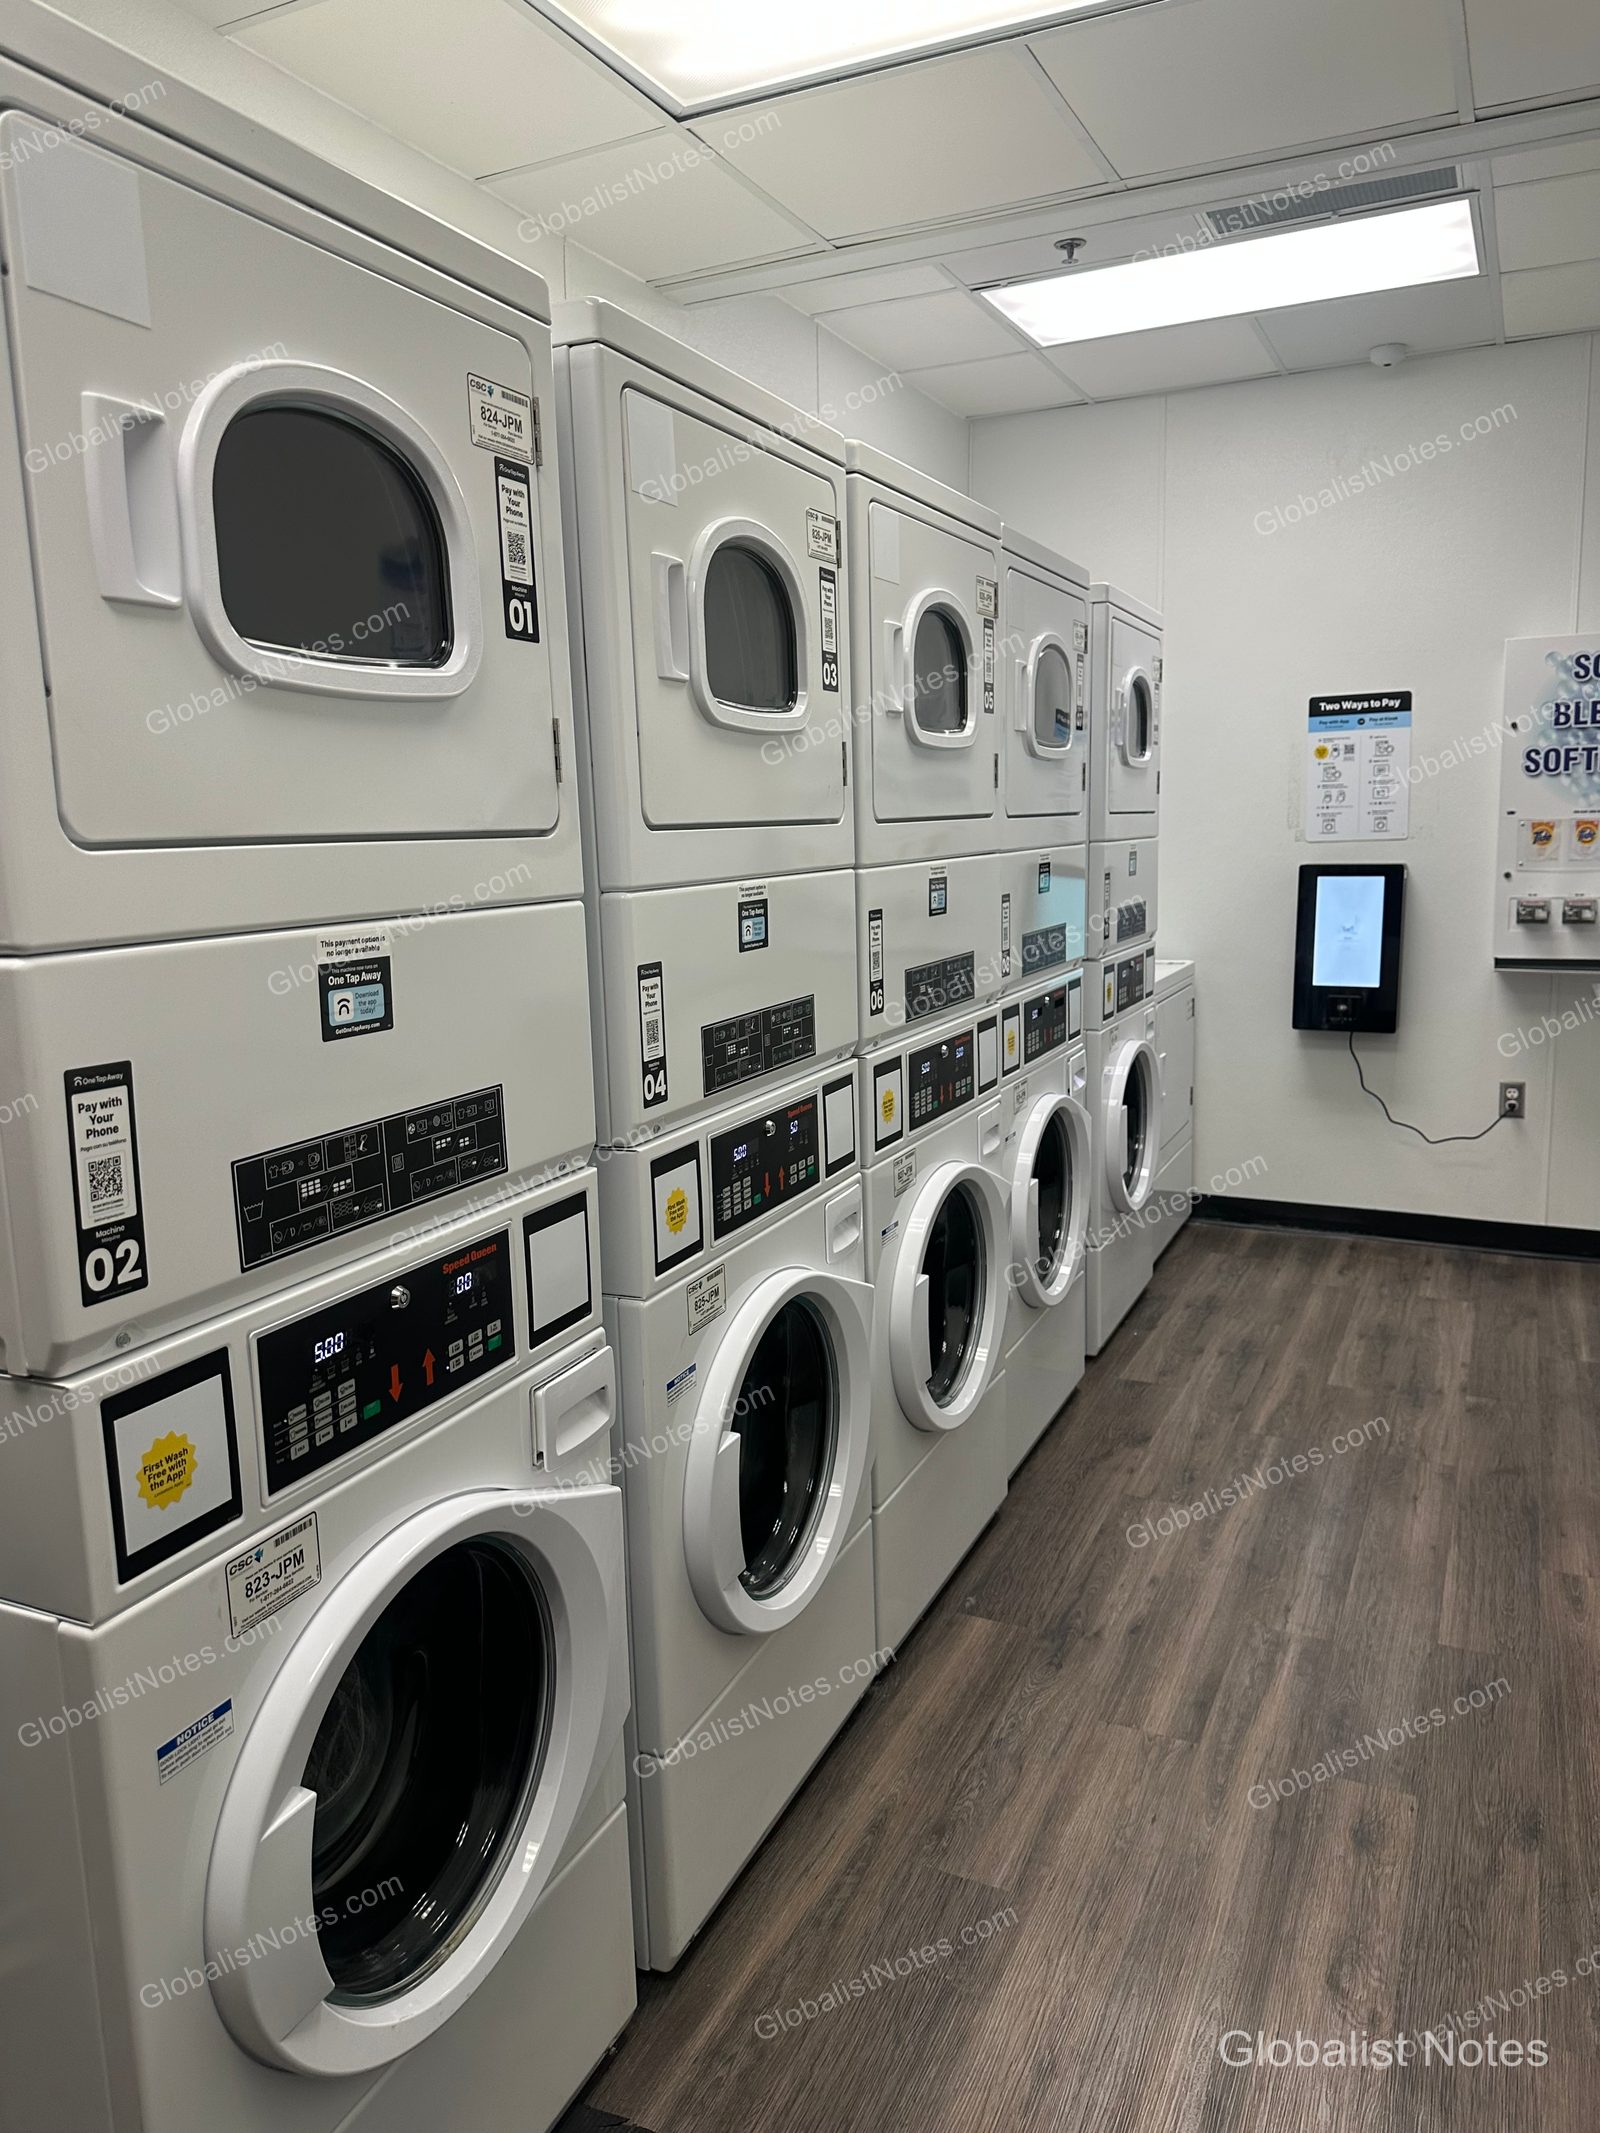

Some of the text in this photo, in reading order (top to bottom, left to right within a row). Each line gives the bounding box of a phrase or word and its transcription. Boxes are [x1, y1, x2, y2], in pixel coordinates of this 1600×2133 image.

[470, 379, 487, 392] CSC
[480, 406, 522, 434] 824-JPM
[502, 484, 525, 498] Pay with
[507, 496, 520, 508] Your
[506, 506, 524, 518] Phone
[509, 598, 534, 634] 01
[824, 662, 837, 686] 03
[1319, 702, 1340, 711] Two
[1341, 700, 1369, 710] Ways
[1382, 698, 1401, 708] Pay
[320, 940, 334, 948] This
[334, 938, 360, 947] payment
[361, 936, 380, 944] option
[335, 948, 354, 956] longer
[355, 944, 380, 954] available
[328, 971, 381, 986] One Tap Away
[354, 990, 379, 999] Download
[871, 989, 883, 1010] 06
[83, 1077, 95, 1085] One
[644, 1069, 666, 1101] 04
[78, 1096, 122, 1114] Pay with
[89, 1113, 114, 1125] Your
[86, 1125, 119, 1139] Phone
[96, 1225, 125, 1238] Machine
[86, 1239, 142, 1292] 02
[442, 1243, 497, 1275] Speed Queen
[694, 1286, 720, 1312] 825-JPM
[314, 1332, 344, 1364] 5.00
[673, 1369, 690, 1384] NOTICE
[144, 1448, 188, 1475] First Wash
[148, 1458, 186, 1482] Free with
[150, 1466, 186, 1491] the App!
[229, 1555, 253, 1575] CSC
[245, 1548, 304, 1598] 823-JPM
[176, 1712, 214, 1746] NOTICE
